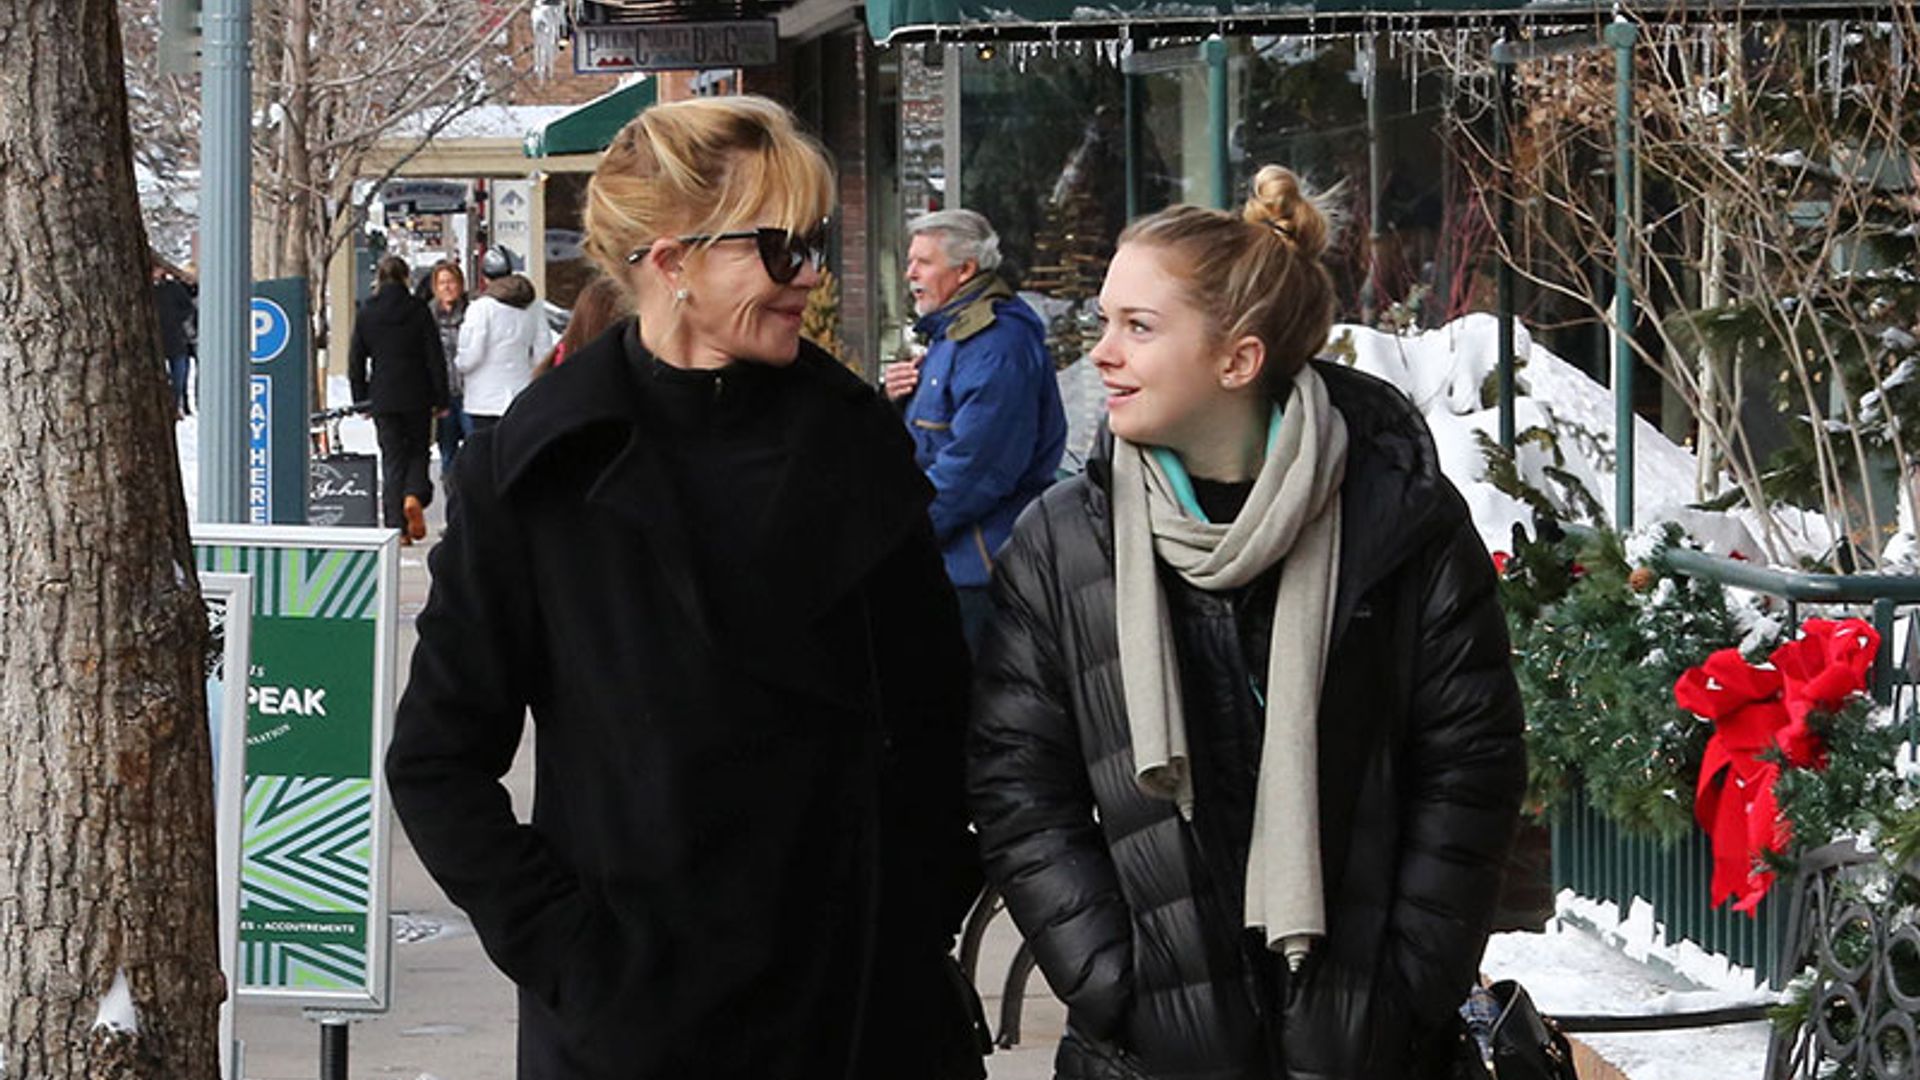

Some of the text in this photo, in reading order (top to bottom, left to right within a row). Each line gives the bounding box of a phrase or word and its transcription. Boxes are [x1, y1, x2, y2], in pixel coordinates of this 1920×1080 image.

[250, 309, 273, 351] P
[249, 381, 266, 525] PAY HERE
[264, 920, 355, 934] ACCOUTREMENTS
